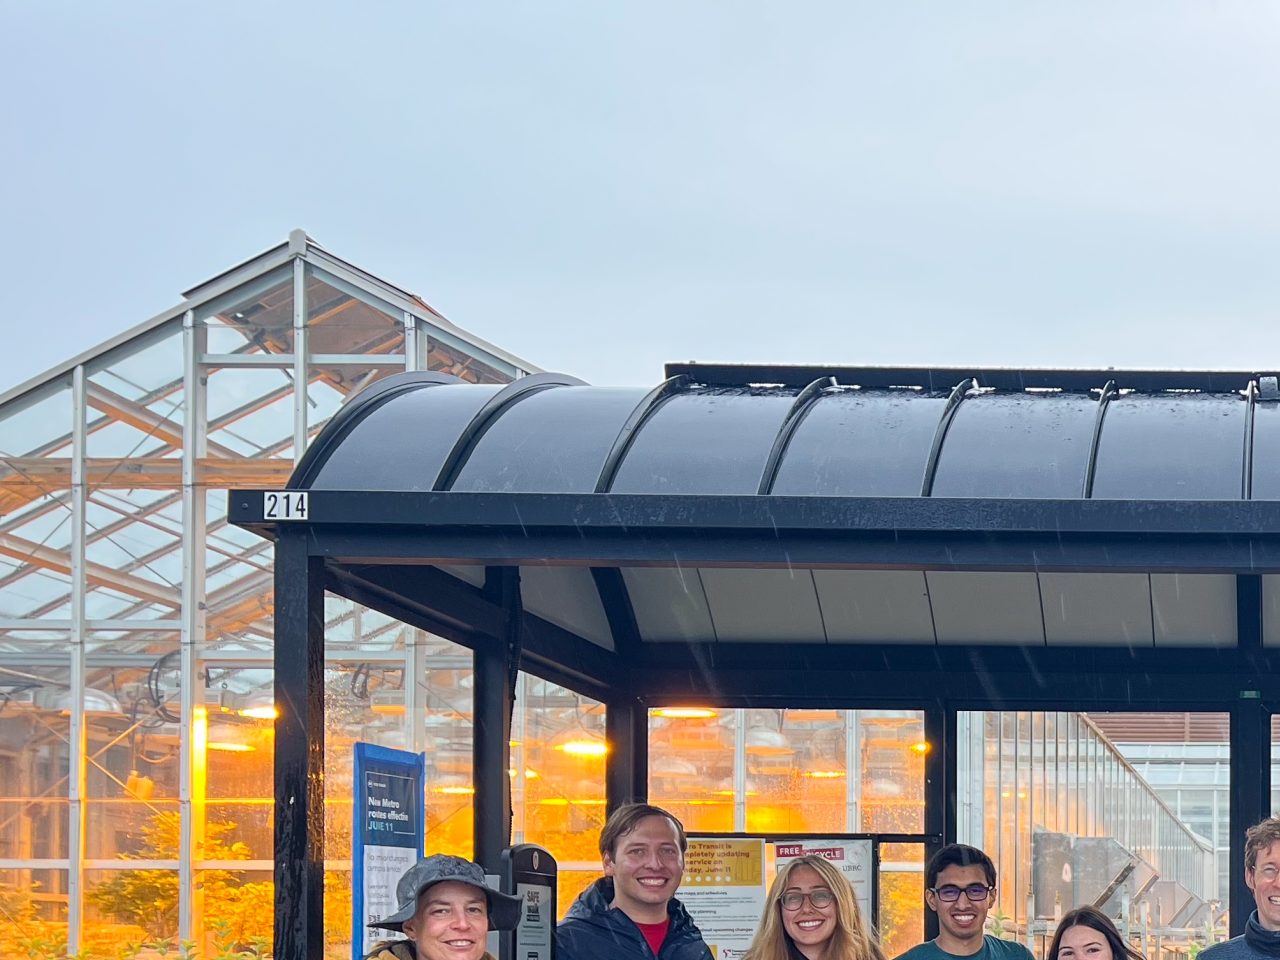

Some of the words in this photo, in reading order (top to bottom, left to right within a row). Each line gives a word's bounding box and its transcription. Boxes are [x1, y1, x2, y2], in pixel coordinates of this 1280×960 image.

[267, 494, 306, 518] 214
[368, 797, 381, 807] New
[382, 798, 400, 809] Metro
[368, 811, 387, 820] routes
[385, 823, 394, 832] 11
[717, 851, 750, 859] updating
[779, 847, 800, 855] FREE
[842, 864, 862, 872] UBRC
